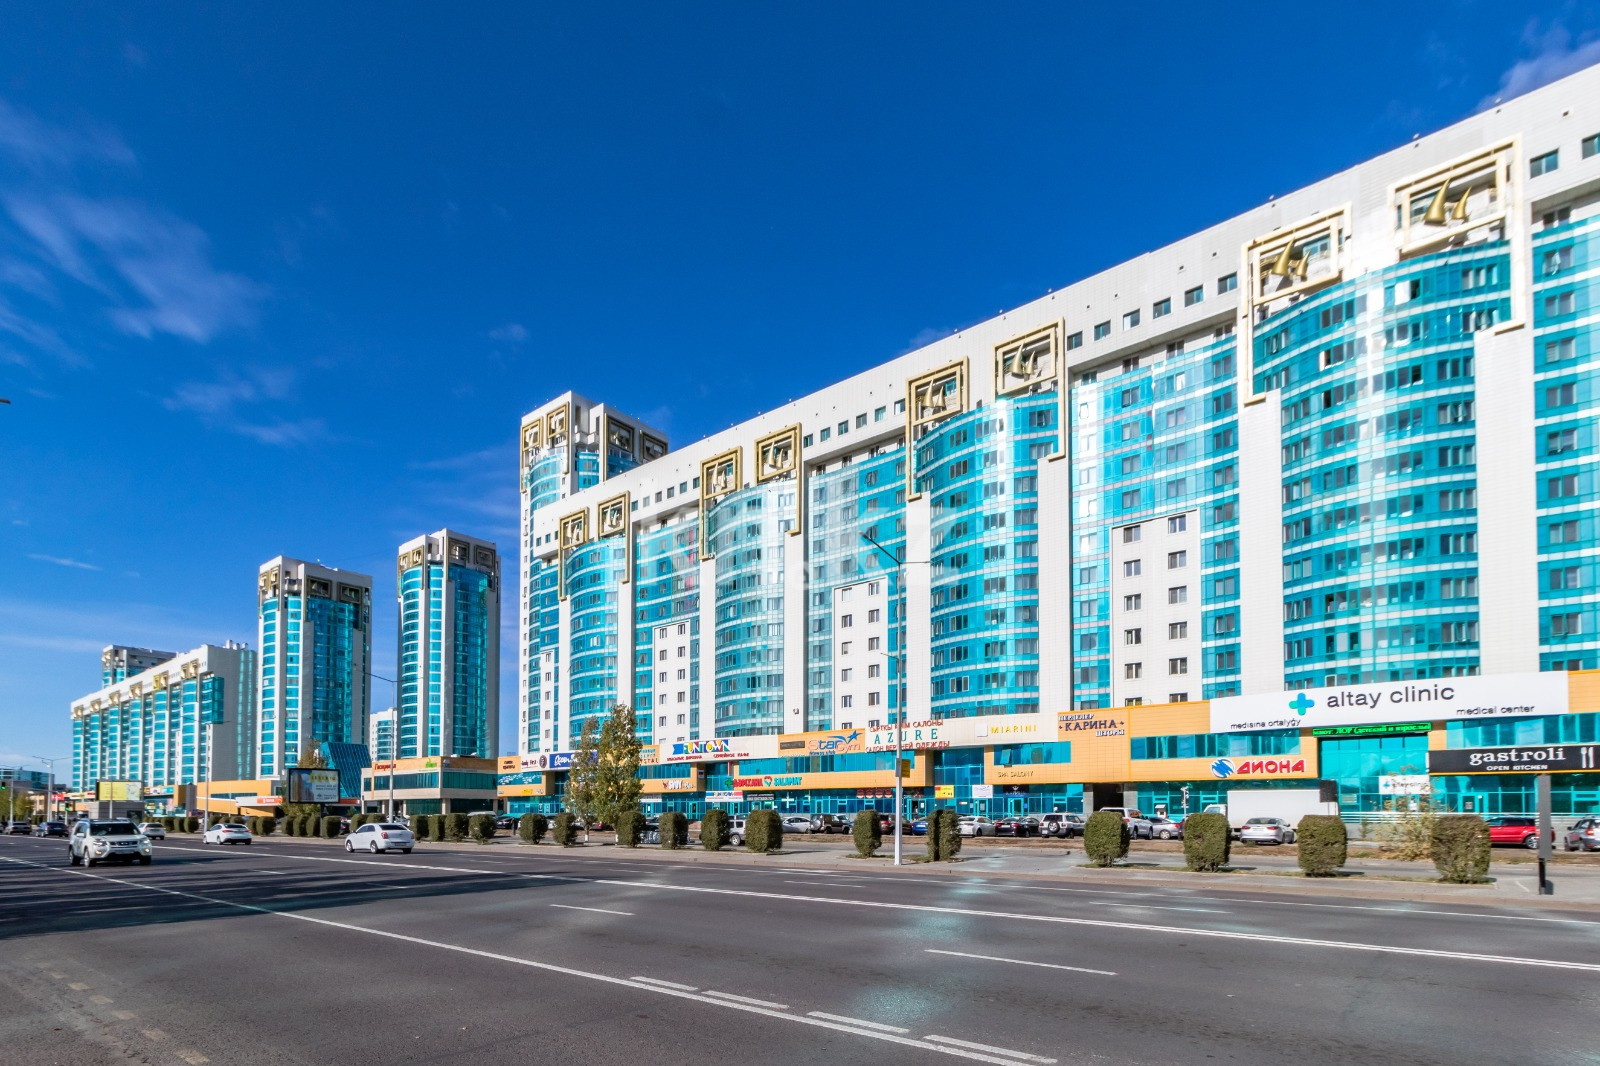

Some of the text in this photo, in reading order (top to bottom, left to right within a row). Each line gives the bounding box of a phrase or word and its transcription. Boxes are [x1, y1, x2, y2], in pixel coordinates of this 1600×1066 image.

[1326, 684, 1456, 709] altay clinic
[1456, 705, 1535, 715] medical center
[912, 719, 944, 728] САЛОНЫ
[991, 725, 1038, 734] MIARINI
[1065, 719, 1118, 732] КАРИНА
[874, 728, 938, 745] AZURE
[683, 739, 731, 755] FUNTOWN
[865, 741, 950, 753] САЛОН ВЕРНЕЙ ОДЕЖДЫ
[1469, 747, 1566, 766] gastroli
[1236, 759, 1305, 774] ДИОНА
